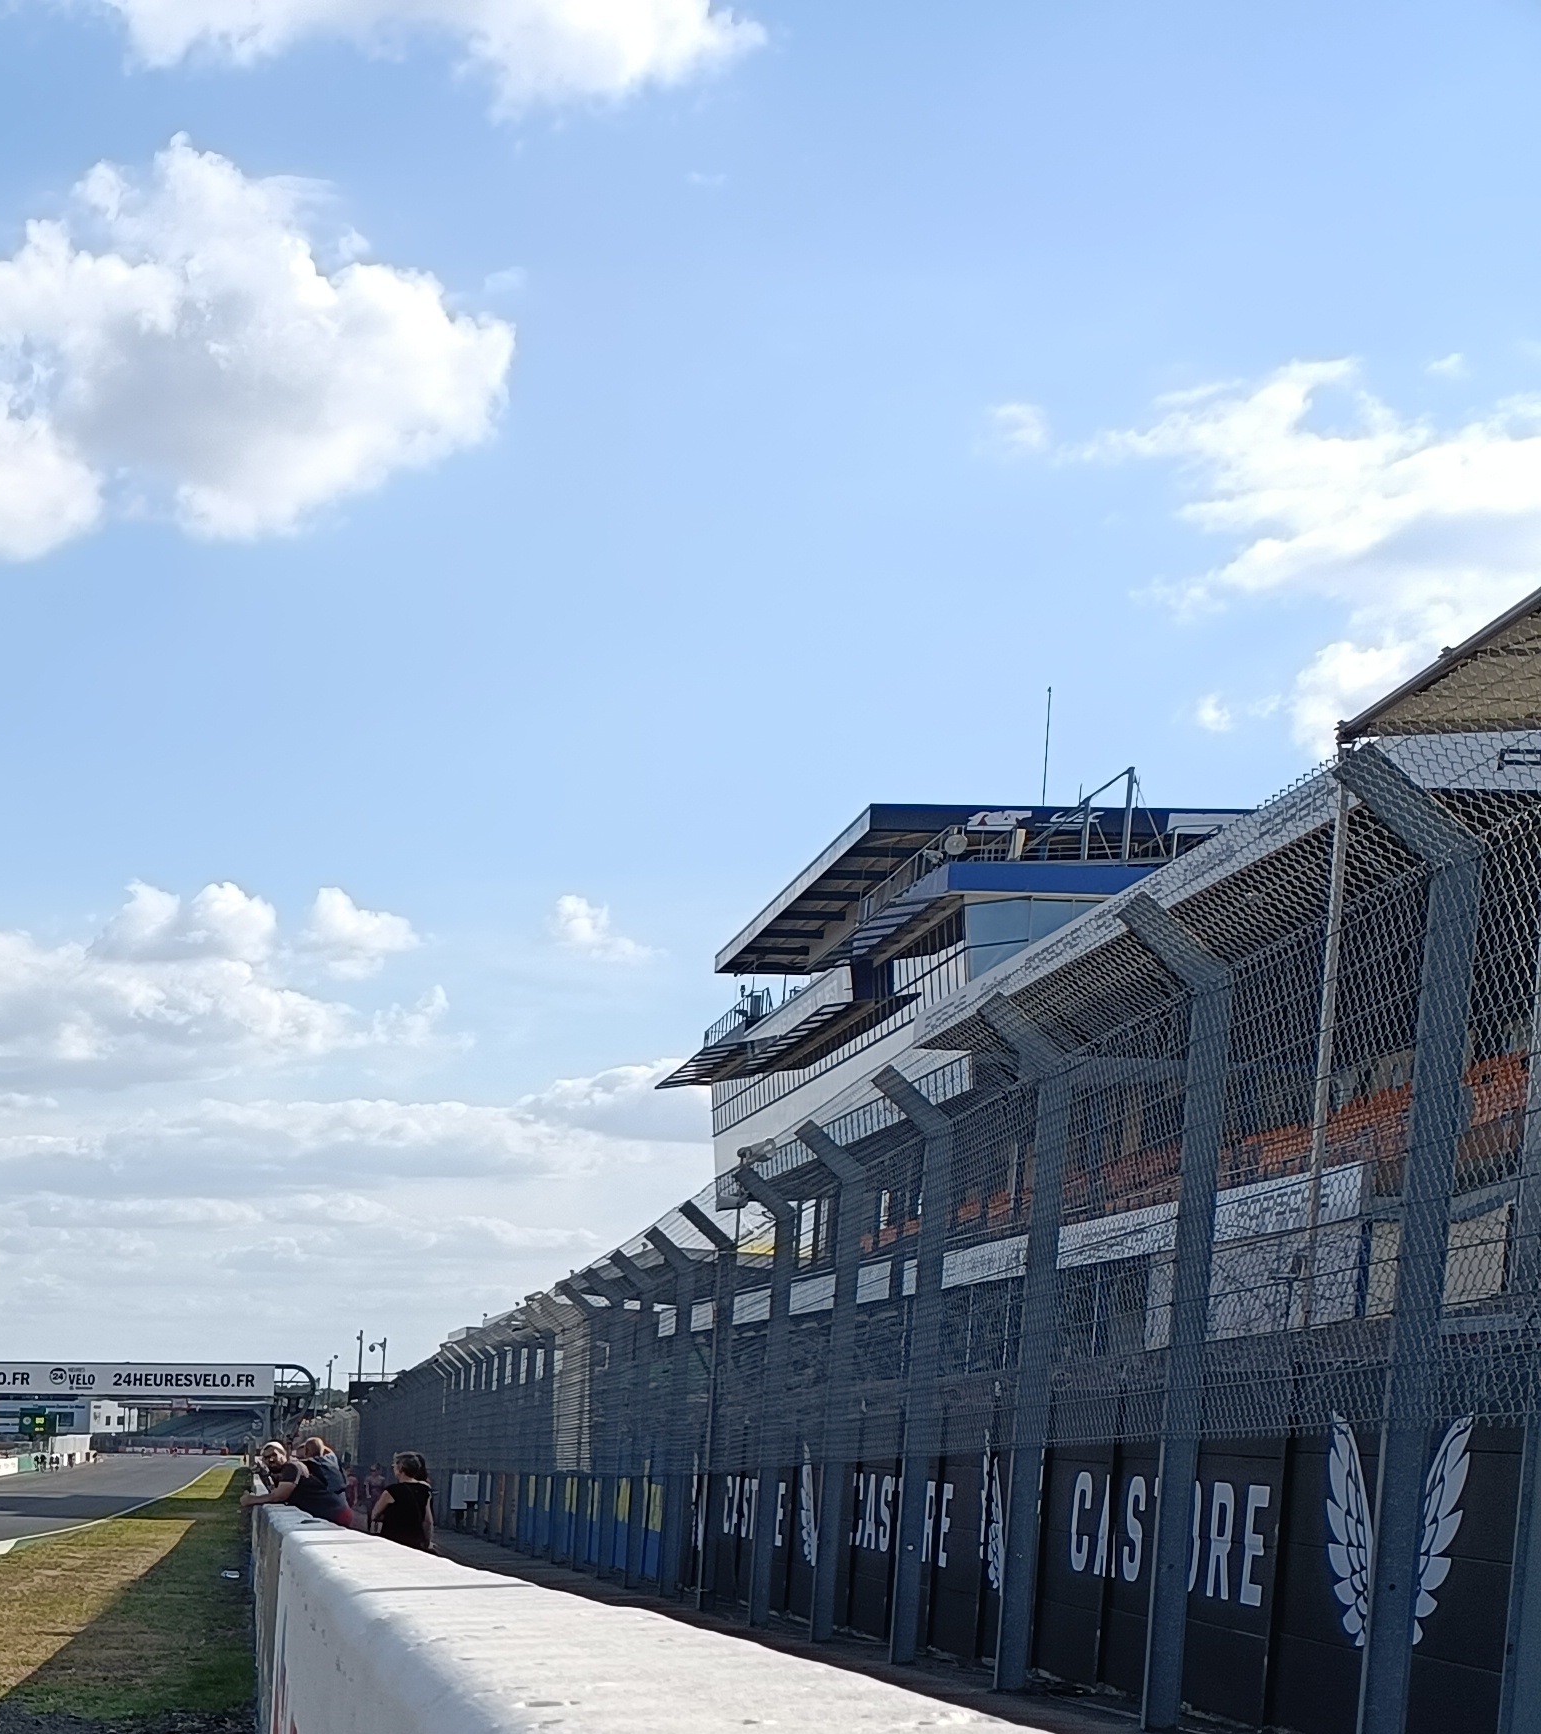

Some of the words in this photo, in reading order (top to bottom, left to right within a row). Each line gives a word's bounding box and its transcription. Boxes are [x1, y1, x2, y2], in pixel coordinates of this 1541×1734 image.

[68, 1374, 96, 1385] VELO
[112, 1373, 256, 1387] 24HEURESVELO.FR
[722, 1475, 787, 1547] CASTE
